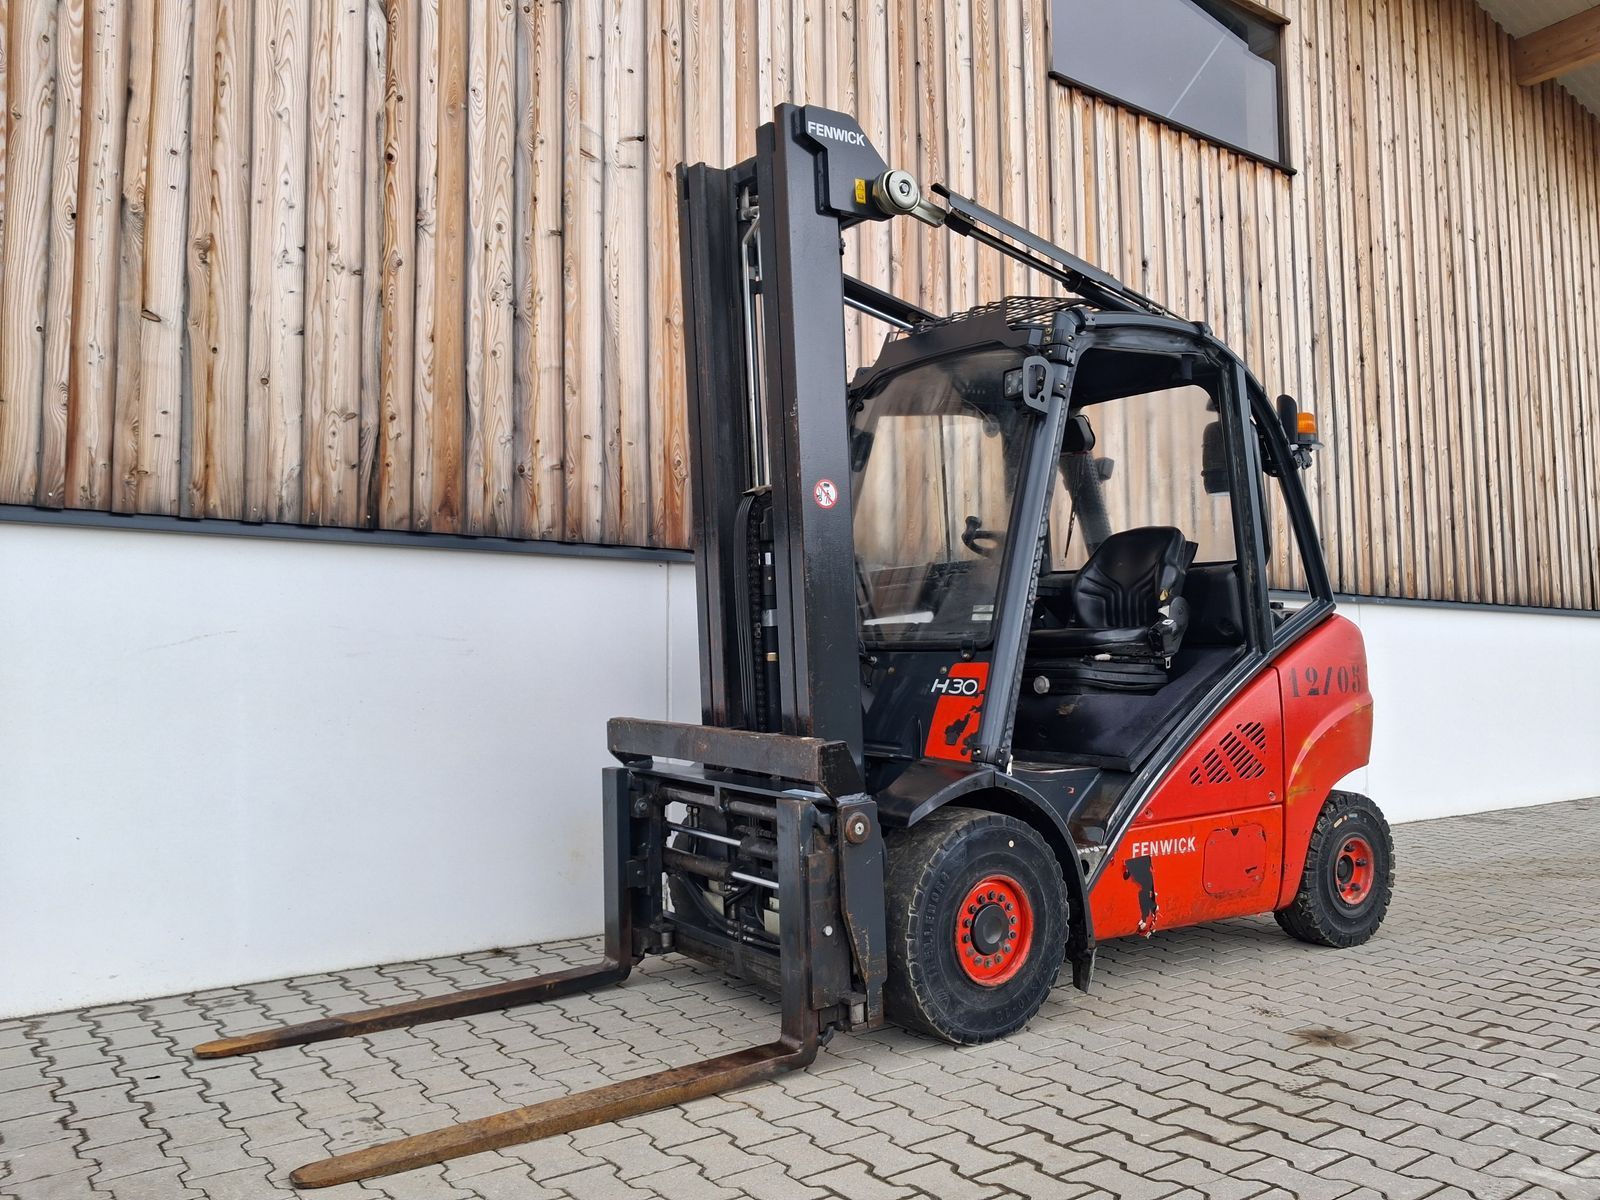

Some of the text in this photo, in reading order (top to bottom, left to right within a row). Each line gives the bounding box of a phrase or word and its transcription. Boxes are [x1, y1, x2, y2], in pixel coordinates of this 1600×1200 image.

[807, 120, 866, 147] FENWICK
[930, 678, 978, 695] H30
[1132, 836, 1196, 858] FENWICK
